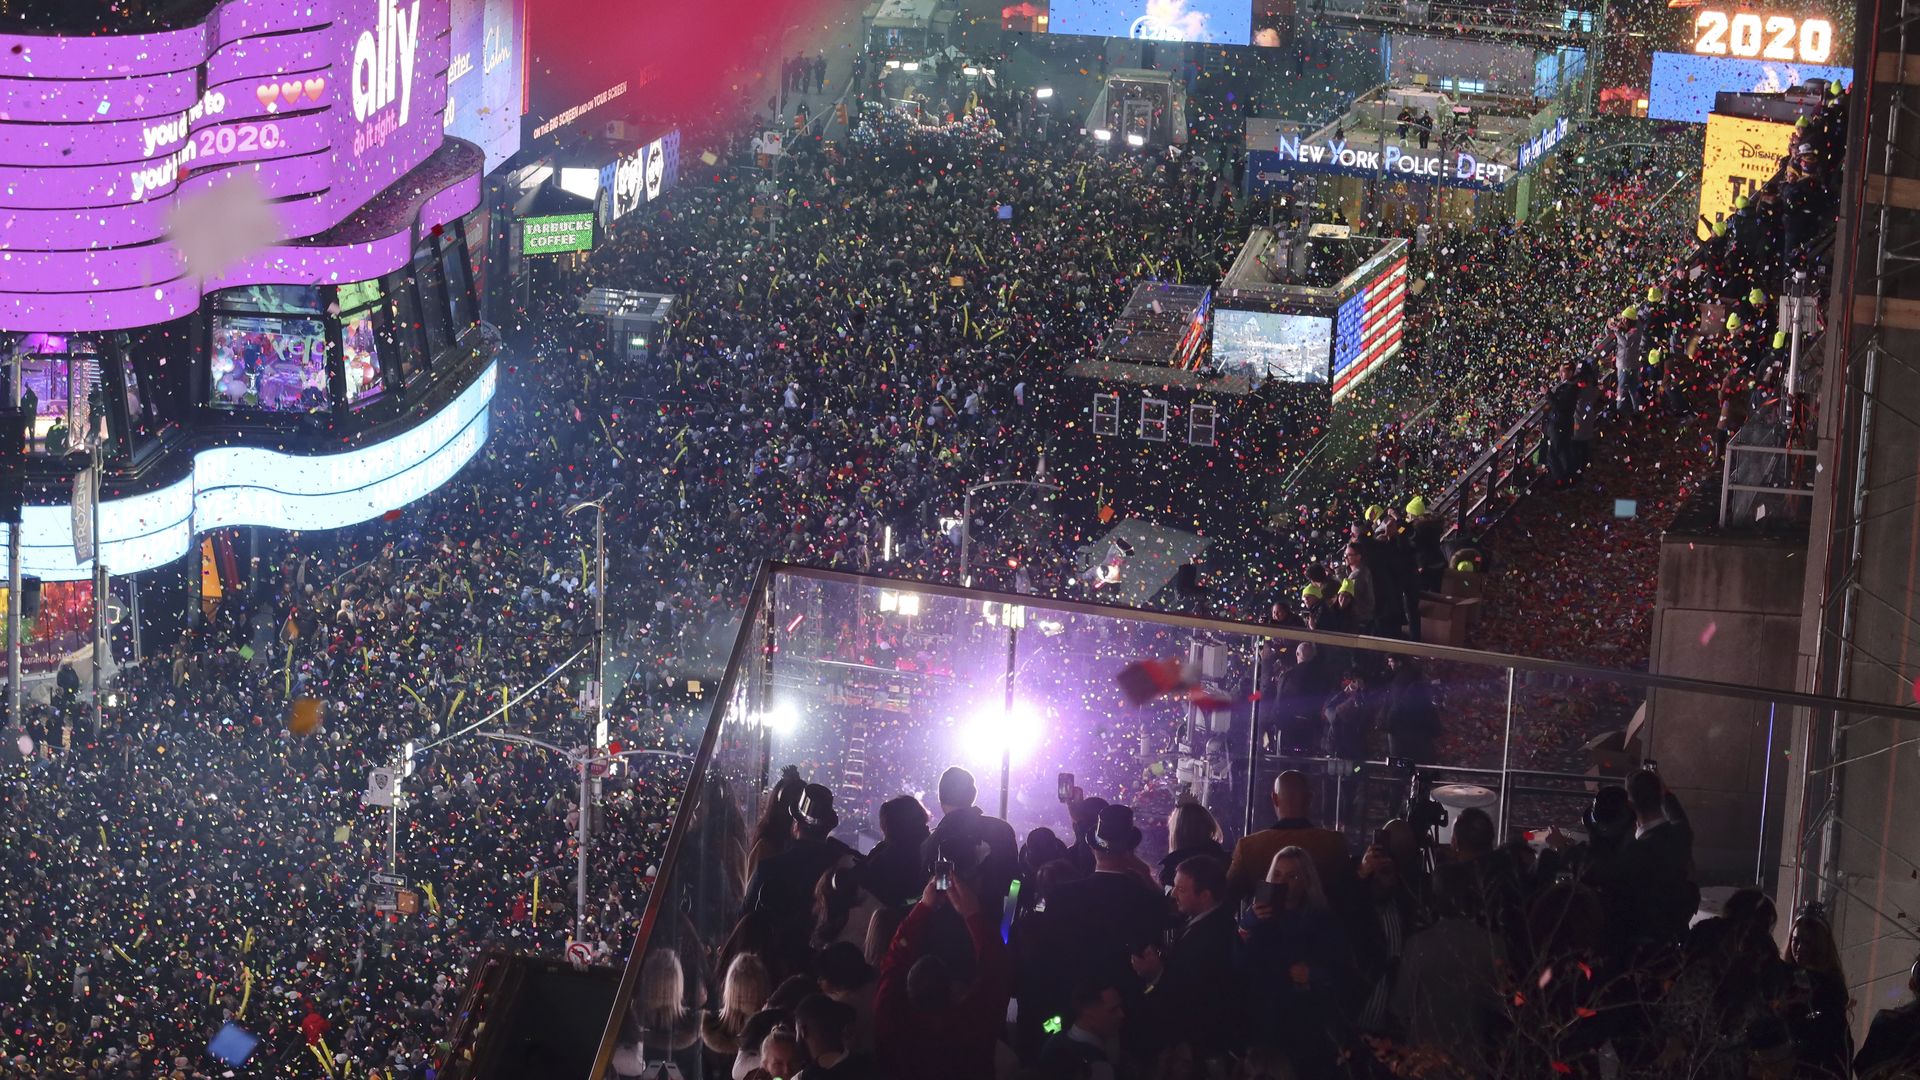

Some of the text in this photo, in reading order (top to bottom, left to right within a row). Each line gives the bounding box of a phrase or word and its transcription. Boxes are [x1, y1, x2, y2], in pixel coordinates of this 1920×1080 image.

[1695, 11, 1832, 62] 2020
[352, 0, 420, 127] ally
[549, 116, 558, 132] BIG
[559, 105, 579, 127] SCREEN
[143, 121, 178, 157] you
[354, 129, 365, 158] do
[526, 220, 592, 235] TARBUCKS
[530, 234, 577, 248] COFFEE
